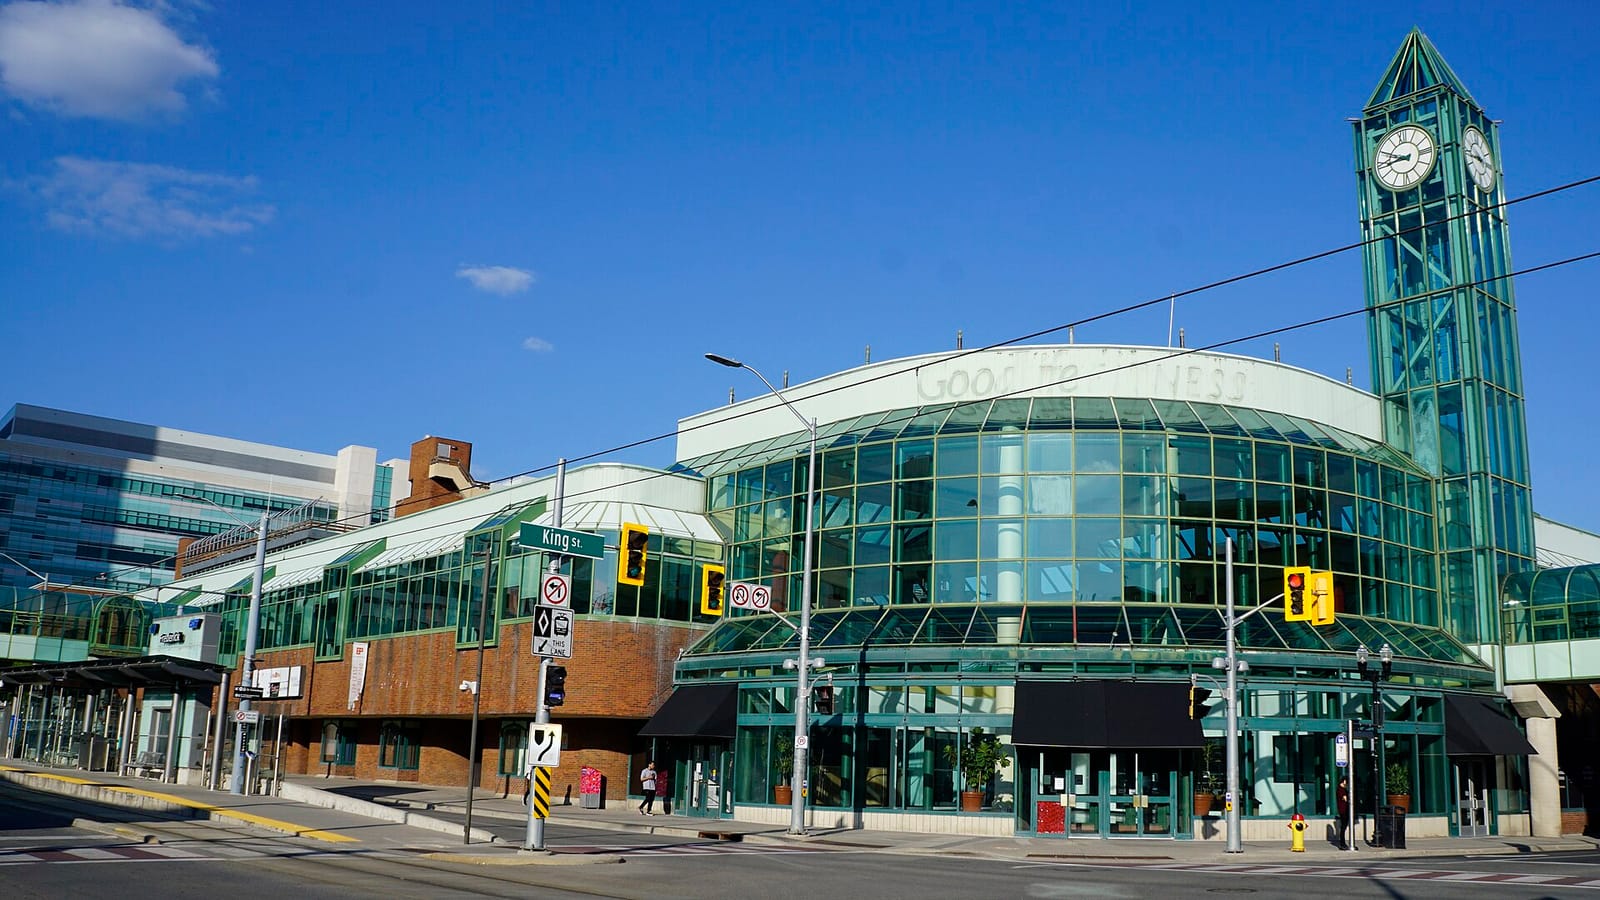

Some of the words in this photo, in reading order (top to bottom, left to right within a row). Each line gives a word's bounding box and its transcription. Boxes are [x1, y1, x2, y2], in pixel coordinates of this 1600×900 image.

[542, 528, 570, 552] King
[571, 537, 583, 549] St.
[552, 639, 566, 648] THIS
[550, 648, 566, 657] LANE
